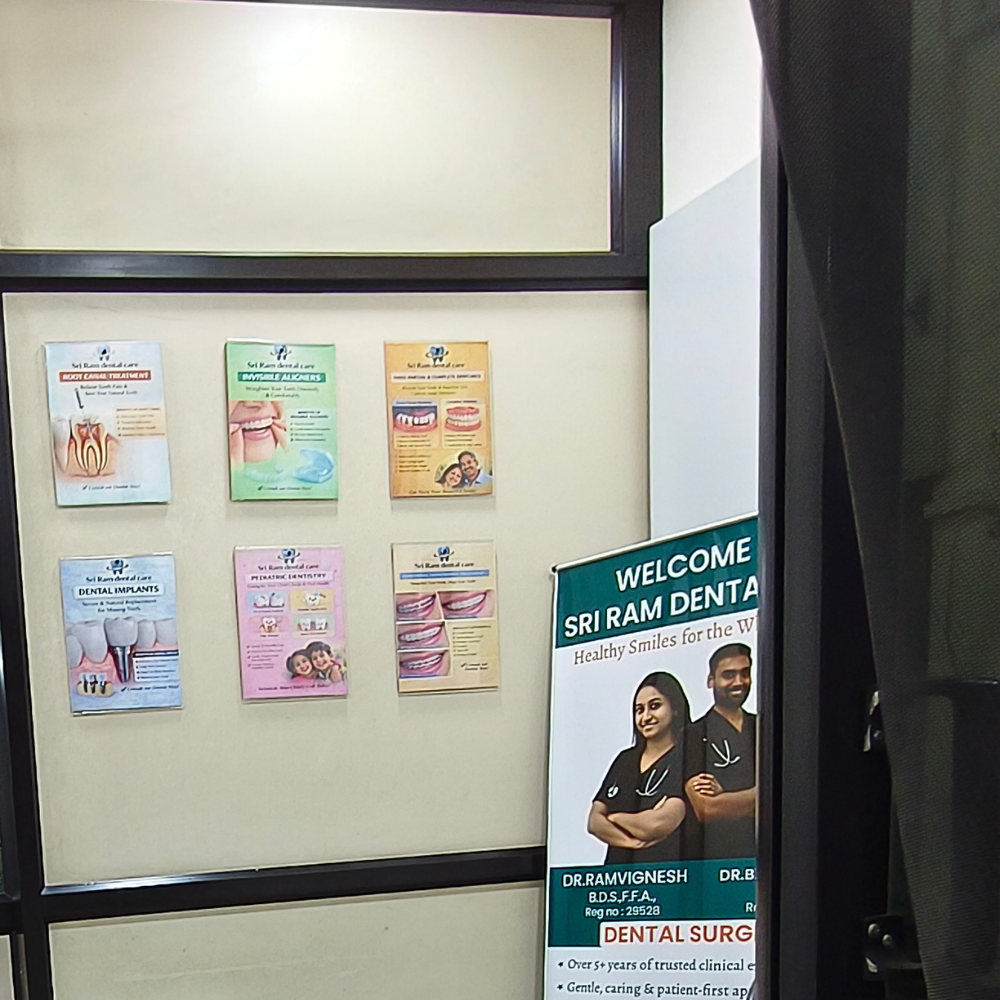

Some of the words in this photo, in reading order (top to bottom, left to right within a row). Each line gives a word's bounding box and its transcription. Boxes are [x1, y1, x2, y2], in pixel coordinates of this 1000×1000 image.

[109, 371, 149, 379] TREATMENT
[242, 373, 279, 381] INVISIBLE
[280, 373, 321, 381] ALIGNERS
[615, 537, 751, 592] WELCOME
[78, 587, 113, 596] DENTAL
[114, 585, 159, 594] IMPLANTS
[564, 610, 600, 638] SRI
[606, 595, 663, 631] RAM
[670, 575, 758, 616] DENTA
[574, 644, 626, 665] Healthy
[629, 633, 677, 654] Smiles
[682, 627, 703, 646] for
[706, 622, 733, 640] the
[737, 616, 758, 635] W
[562, 869, 688, 888] DR.RAMVIGNESH
[719, 868, 757, 882] DR.B
[585, 907, 604, 919] Reg
[605, 908, 619, 917] no
[626, 905, 660, 916] 29528
[604, 925, 685, 943] DENTAL
[690, 925, 753, 943] SURG
[567, 958, 592, 970] Over
[594, 959, 605, 971] 5+
[606, 961, 637, 973] years
[639, 958, 654, 970] of
[655, 959, 697, 971] trusted
[699, 958, 745, 971] clinical
[567, 982, 603, 995] Gentle,
[605, 983, 641, 996] caring
[644, 984, 654, 995] &
[657, 983, 729, 999] patient-first
